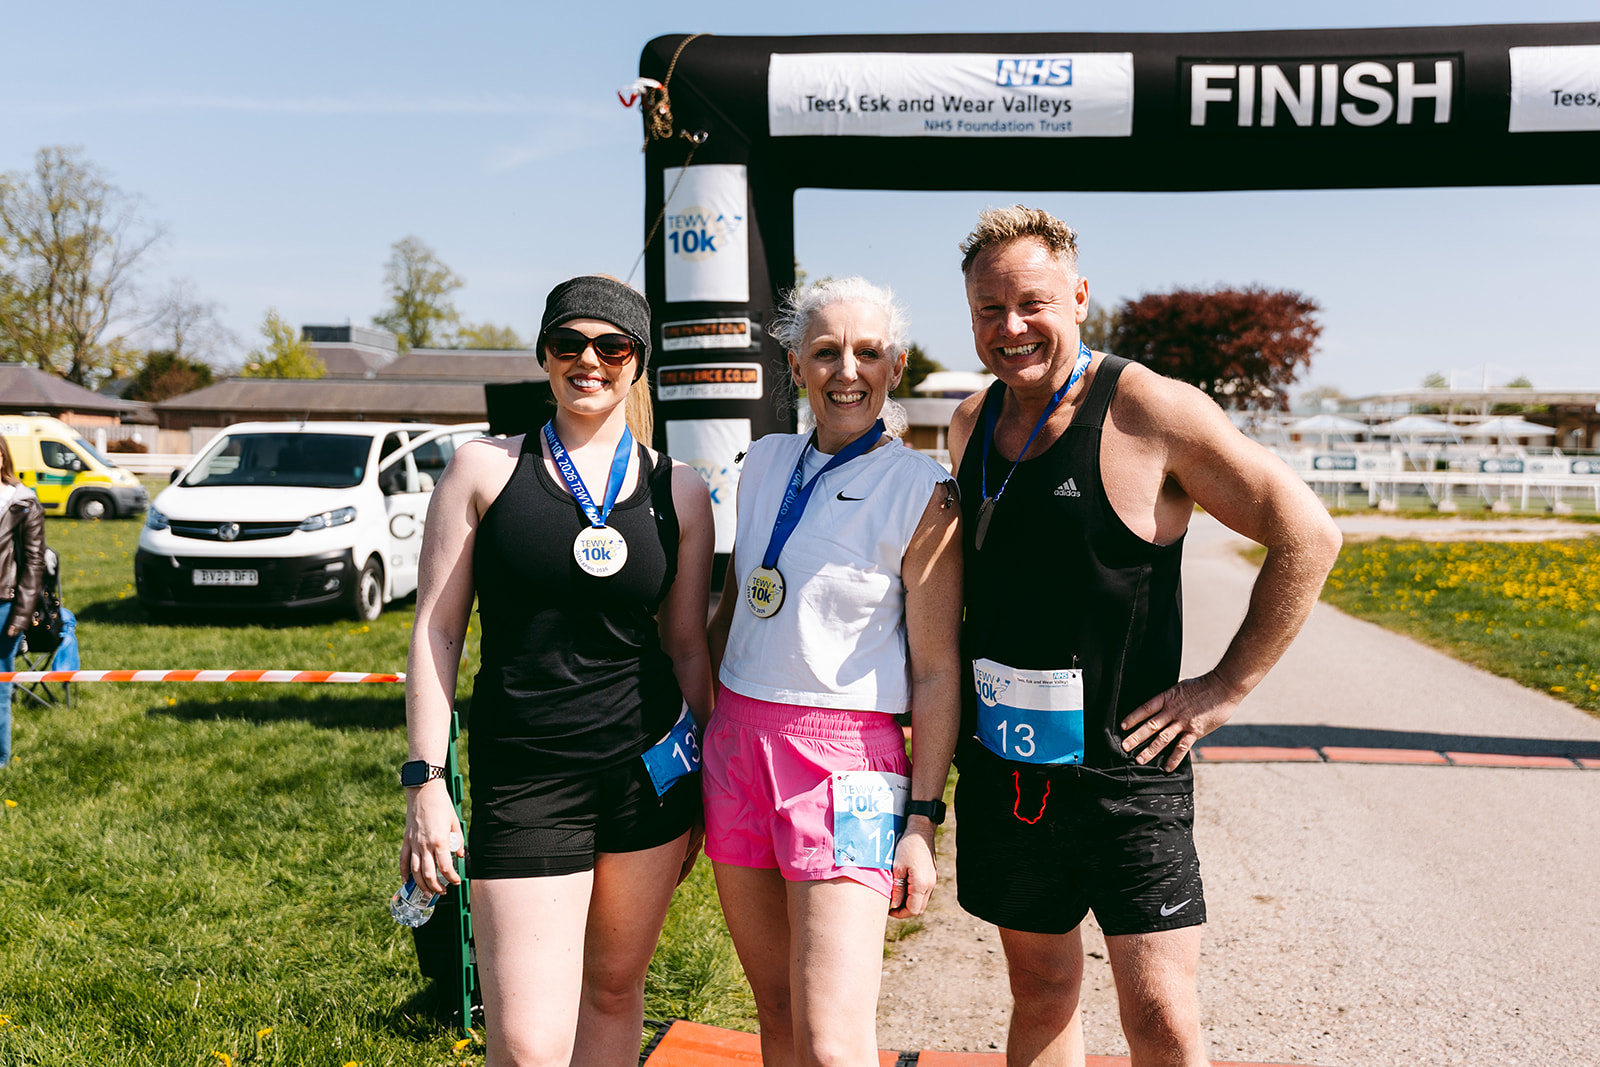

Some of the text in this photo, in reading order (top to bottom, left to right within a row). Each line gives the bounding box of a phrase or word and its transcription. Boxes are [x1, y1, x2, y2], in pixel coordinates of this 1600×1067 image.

[998, 59, 1072, 86] NHS
[1190, 60, 1453, 127] FINISH
[806, 95, 1072, 117] Tees, Esk and Wear Valleys
[924, 120, 1072, 132] NHS Foundation Trust
[668, 214, 711, 228] TEWV
[668, 229, 717, 254] 10k
[551, 442, 565, 460] 10k
[558, 458, 578, 482] 2026
[571, 481, 593, 506] TEWV
[582, 547, 611, 561] 10k
[753, 577, 772, 589] TEWV
[751, 585, 771, 604] 10k
[975, 668, 996, 684] TEWV
[976, 680, 998, 703] 10k
[997, 720, 1036, 757] 13
[842, 785, 874, 795] TEWV
[843, 794, 880, 812] 10k
